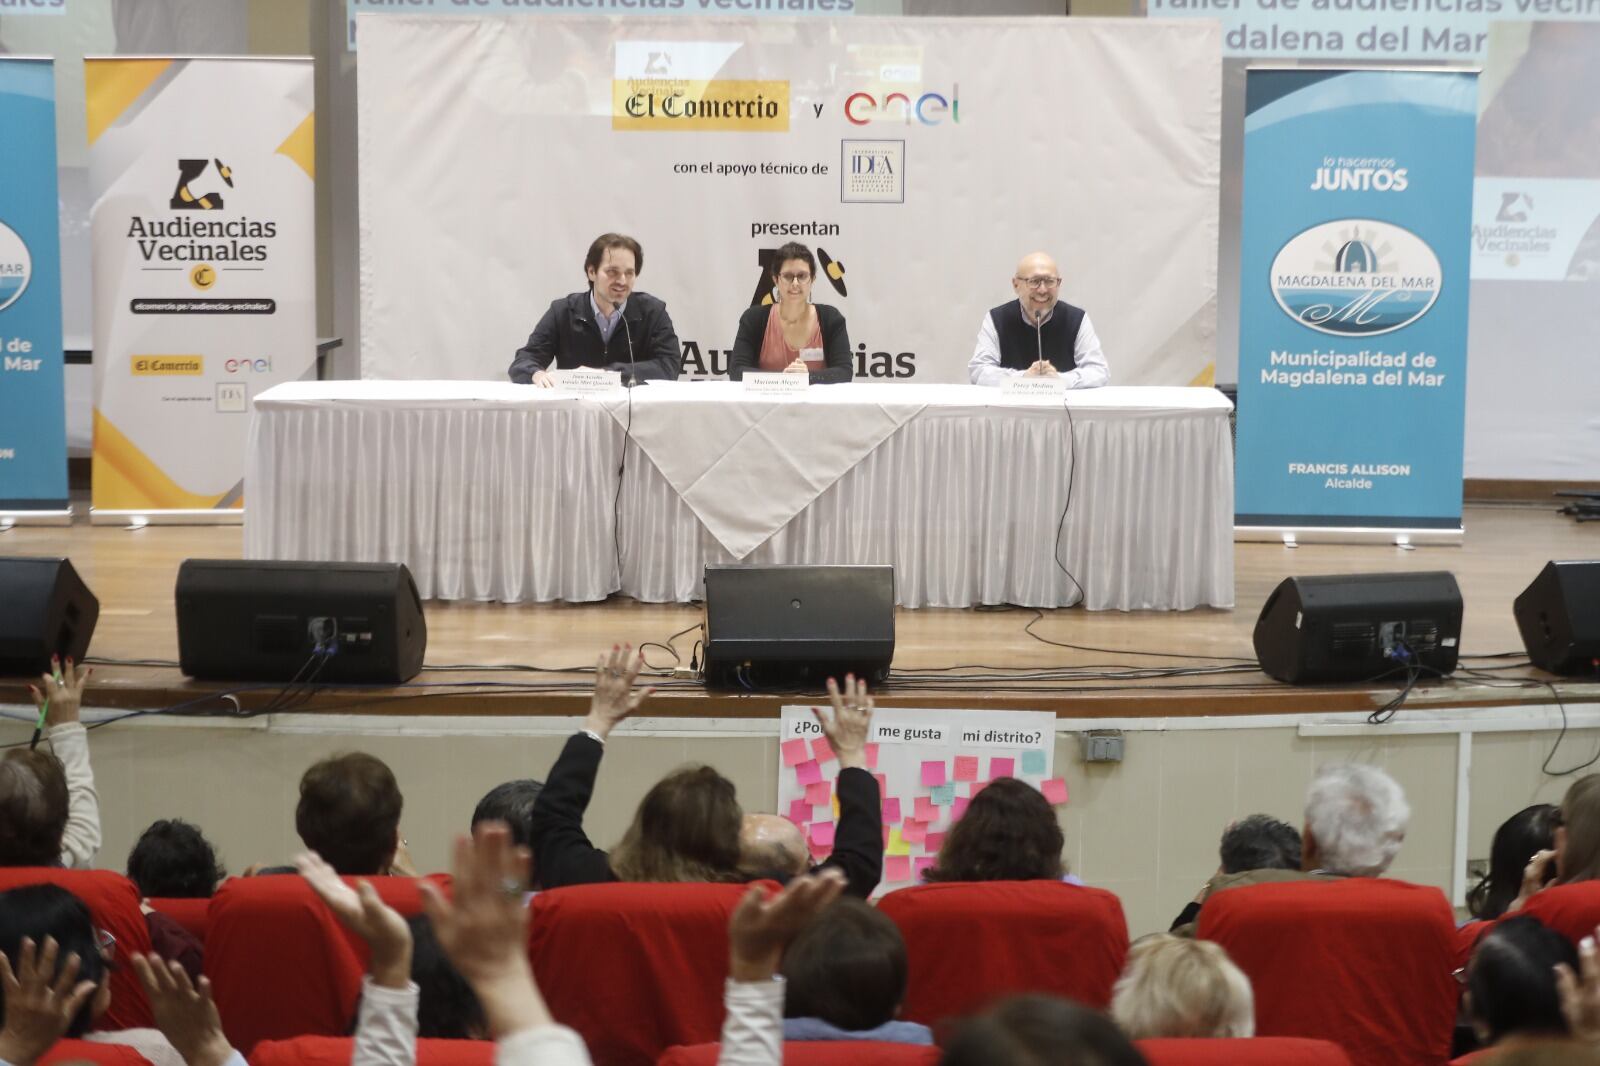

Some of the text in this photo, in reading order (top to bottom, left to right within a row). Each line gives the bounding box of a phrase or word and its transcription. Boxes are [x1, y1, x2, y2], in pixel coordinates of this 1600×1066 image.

[1356, 25, 1409, 51] del
[1422, 27, 1488, 52] Mar
[624, 82, 960, 126] El Comercio y enel
[673, 161, 829, 177] con el apoyo técnico de
[1323, 156, 1397, 168] lo hacemos
[1310, 167, 1409, 192] JUNTOS
[126, 216, 277, 238] Audiencias
[751, 221, 841, 239] presentan
[1472, 224, 1557, 239] Audiencias
[137, 240, 268, 262] Vecinales
[1475, 240, 1551, 253] Vecinales
[1277, 275, 1435, 289] MAGDALENA DEL MAR
[6, 338, 32, 353] de
[4, 356, 43, 371] Mar
[134, 356, 273, 374] El Comercio enel
[1270, 350, 1437, 370] Municipalidad de
[1260, 368, 1446, 388] Magdalena del Mar
[1287, 463, 1411, 476] FRANCIS ALLISON
[1324, 477, 1373, 489] Alcalde
[878, 726, 901, 738] me
[904, 724, 942, 741] gusta
[962, 730, 980, 743] mi
[984, 729, 1042, 745] distrito?
